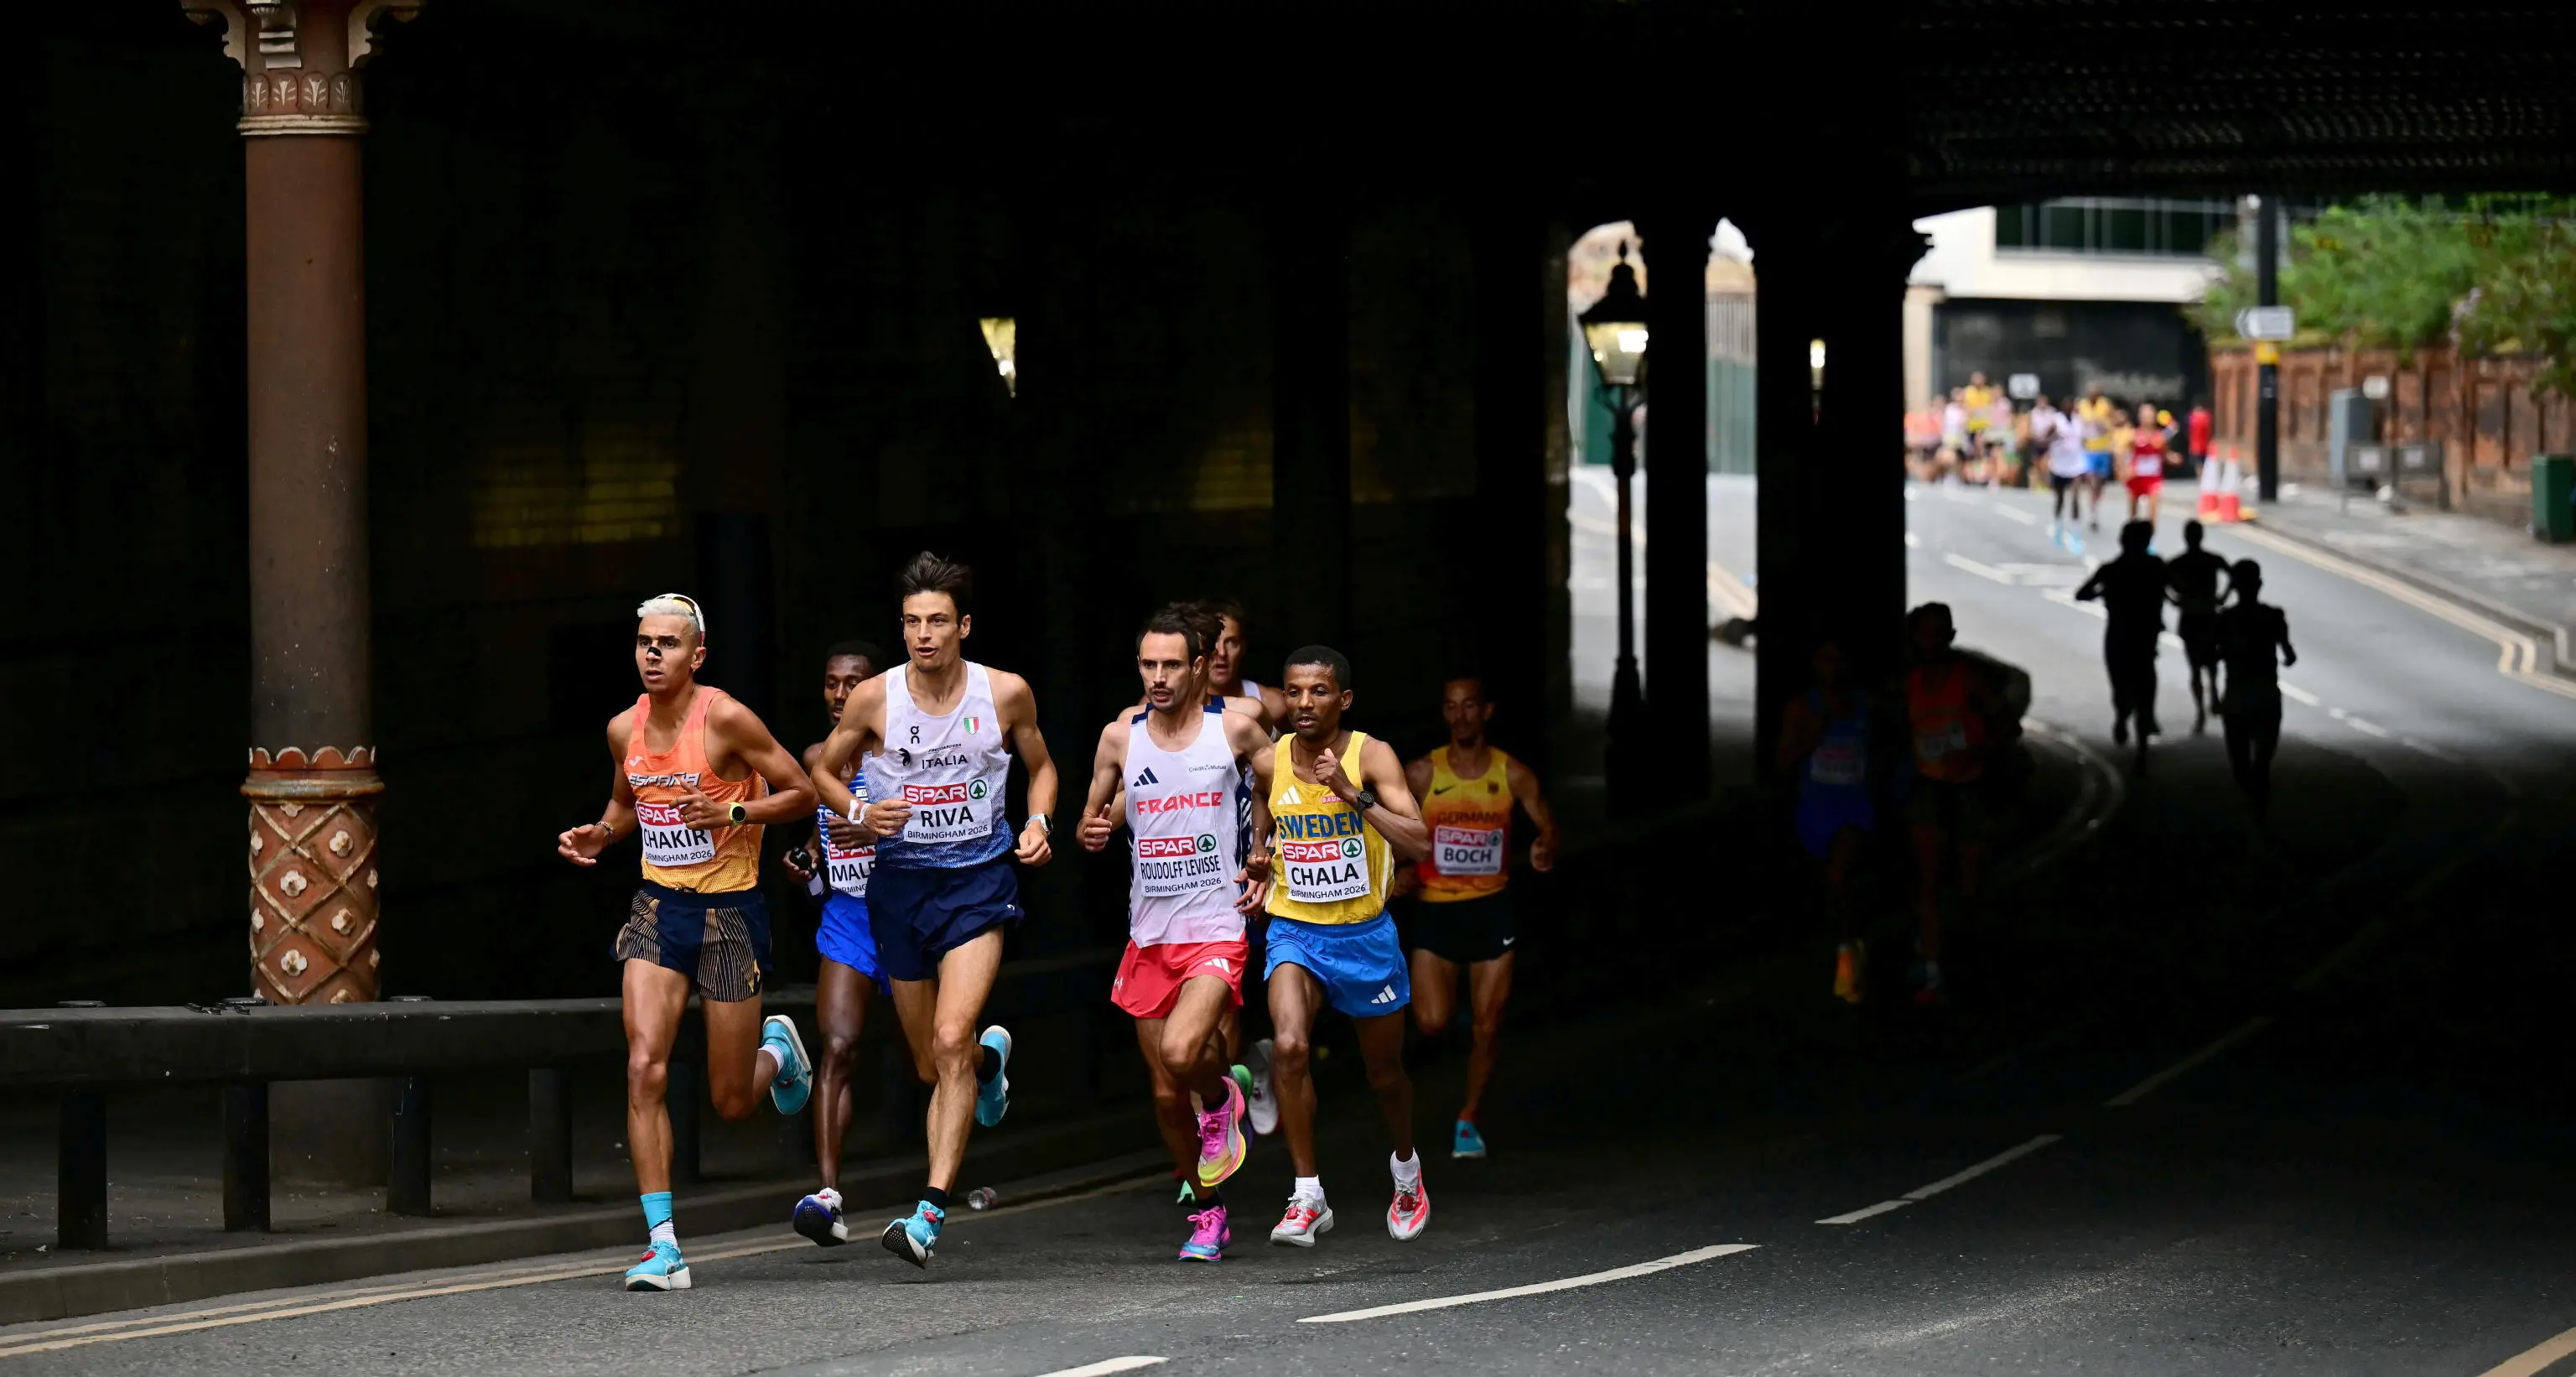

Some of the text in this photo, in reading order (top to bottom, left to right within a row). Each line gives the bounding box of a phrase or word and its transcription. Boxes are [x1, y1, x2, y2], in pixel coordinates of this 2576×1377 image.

[922, 755, 968, 769] ITALIA
[906, 786, 967, 803] SPAR
[1135, 792, 1223, 816] FRANCE
[637, 807, 682, 824] SPAR
[920, 806, 974, 828] RIVA
[907, 824, 988, 840] BIRMINGHAM 2026
[1275, 812, 1363, 839] SWEDEN
[643, 828, 709, 850] CHAKIR
[1438, 829, 1486, 844] SPAR
[1140, 839, 1194, 855] SPAR
[1283, 843, 1339, 860] SPAR
[1443, 847, 1492, 863] BOCH
[646, 850, 712, 863] BIRMINGHAM 2026
[1140, 855, 1221, 880] ROUDOLFF LEVISSE
[1291, 863, 1359, 886] CHALA
[1145, 877, 1222, 893] BIRMINGHAM 2026
[1291, 884, 1366, 899] BIRMINGHAM 2026
